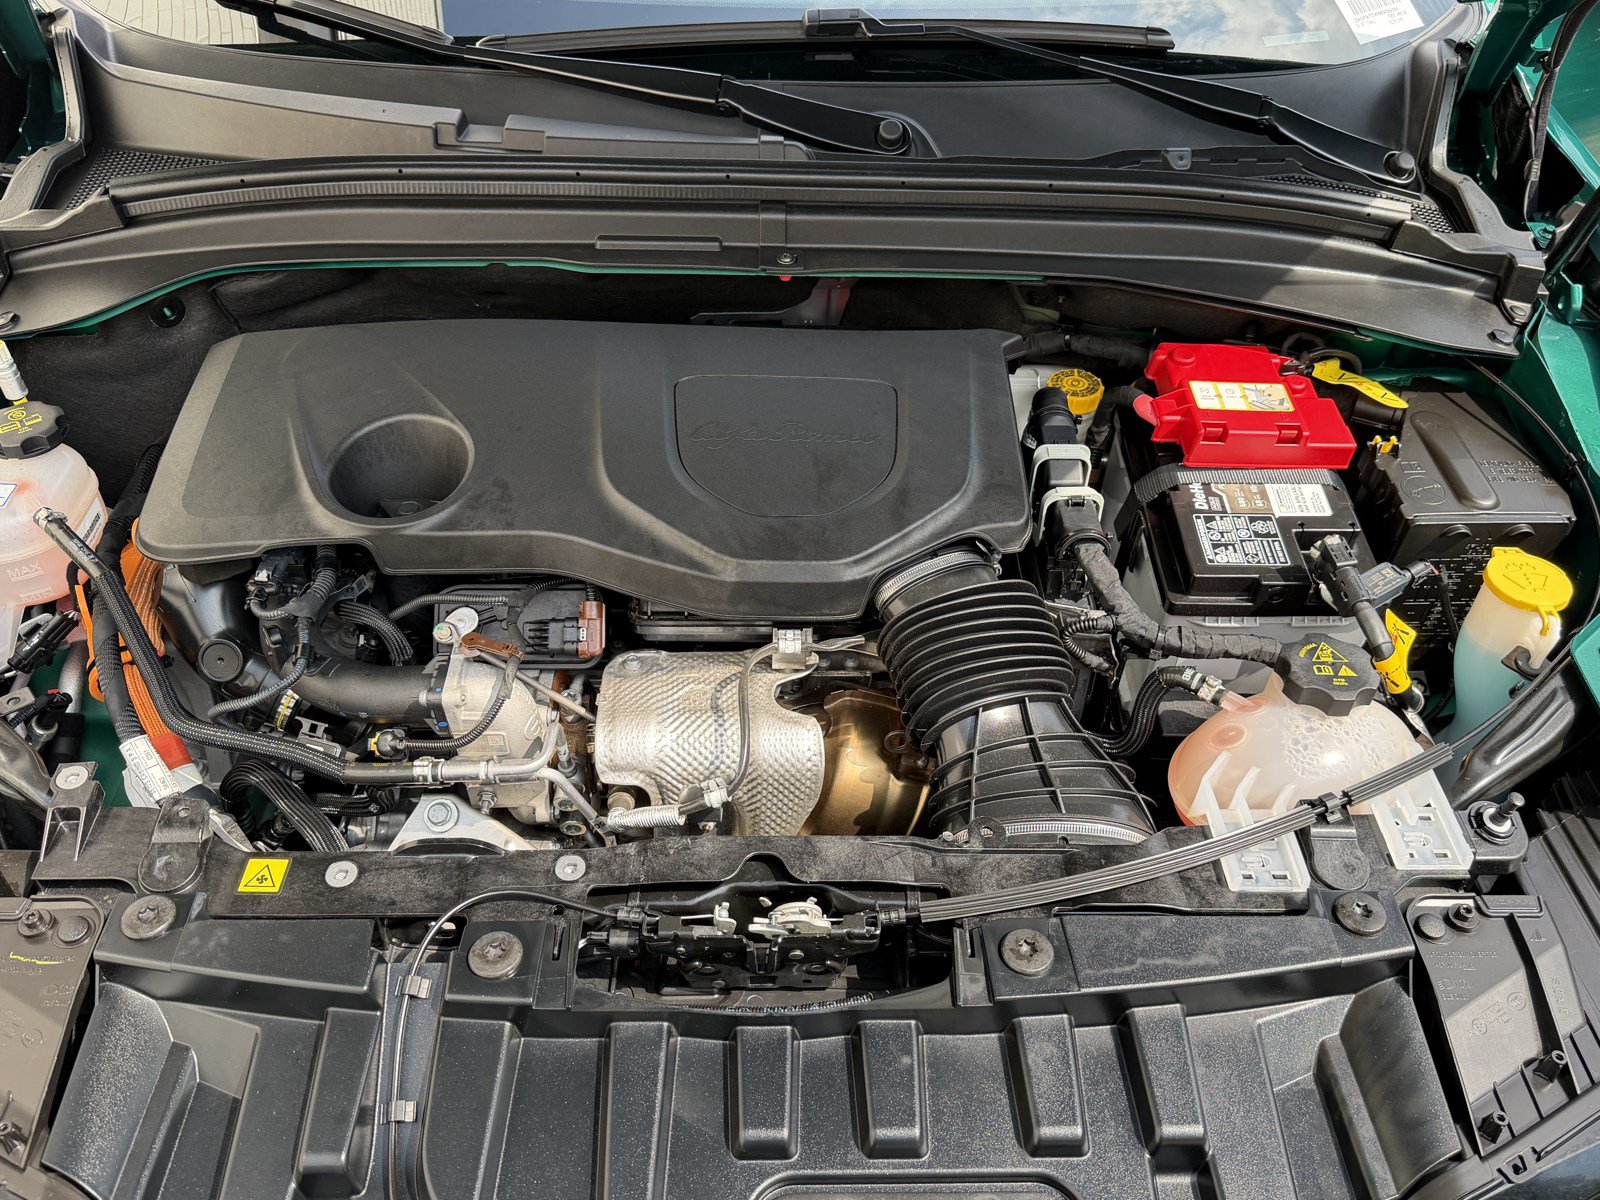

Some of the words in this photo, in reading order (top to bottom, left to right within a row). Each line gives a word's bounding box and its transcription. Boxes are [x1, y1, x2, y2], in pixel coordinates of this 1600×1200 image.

[690, 422, 768, 450] Alfa
[767, 422, 883, 443] Romeo
[6, 562, 42, 578] MAX
